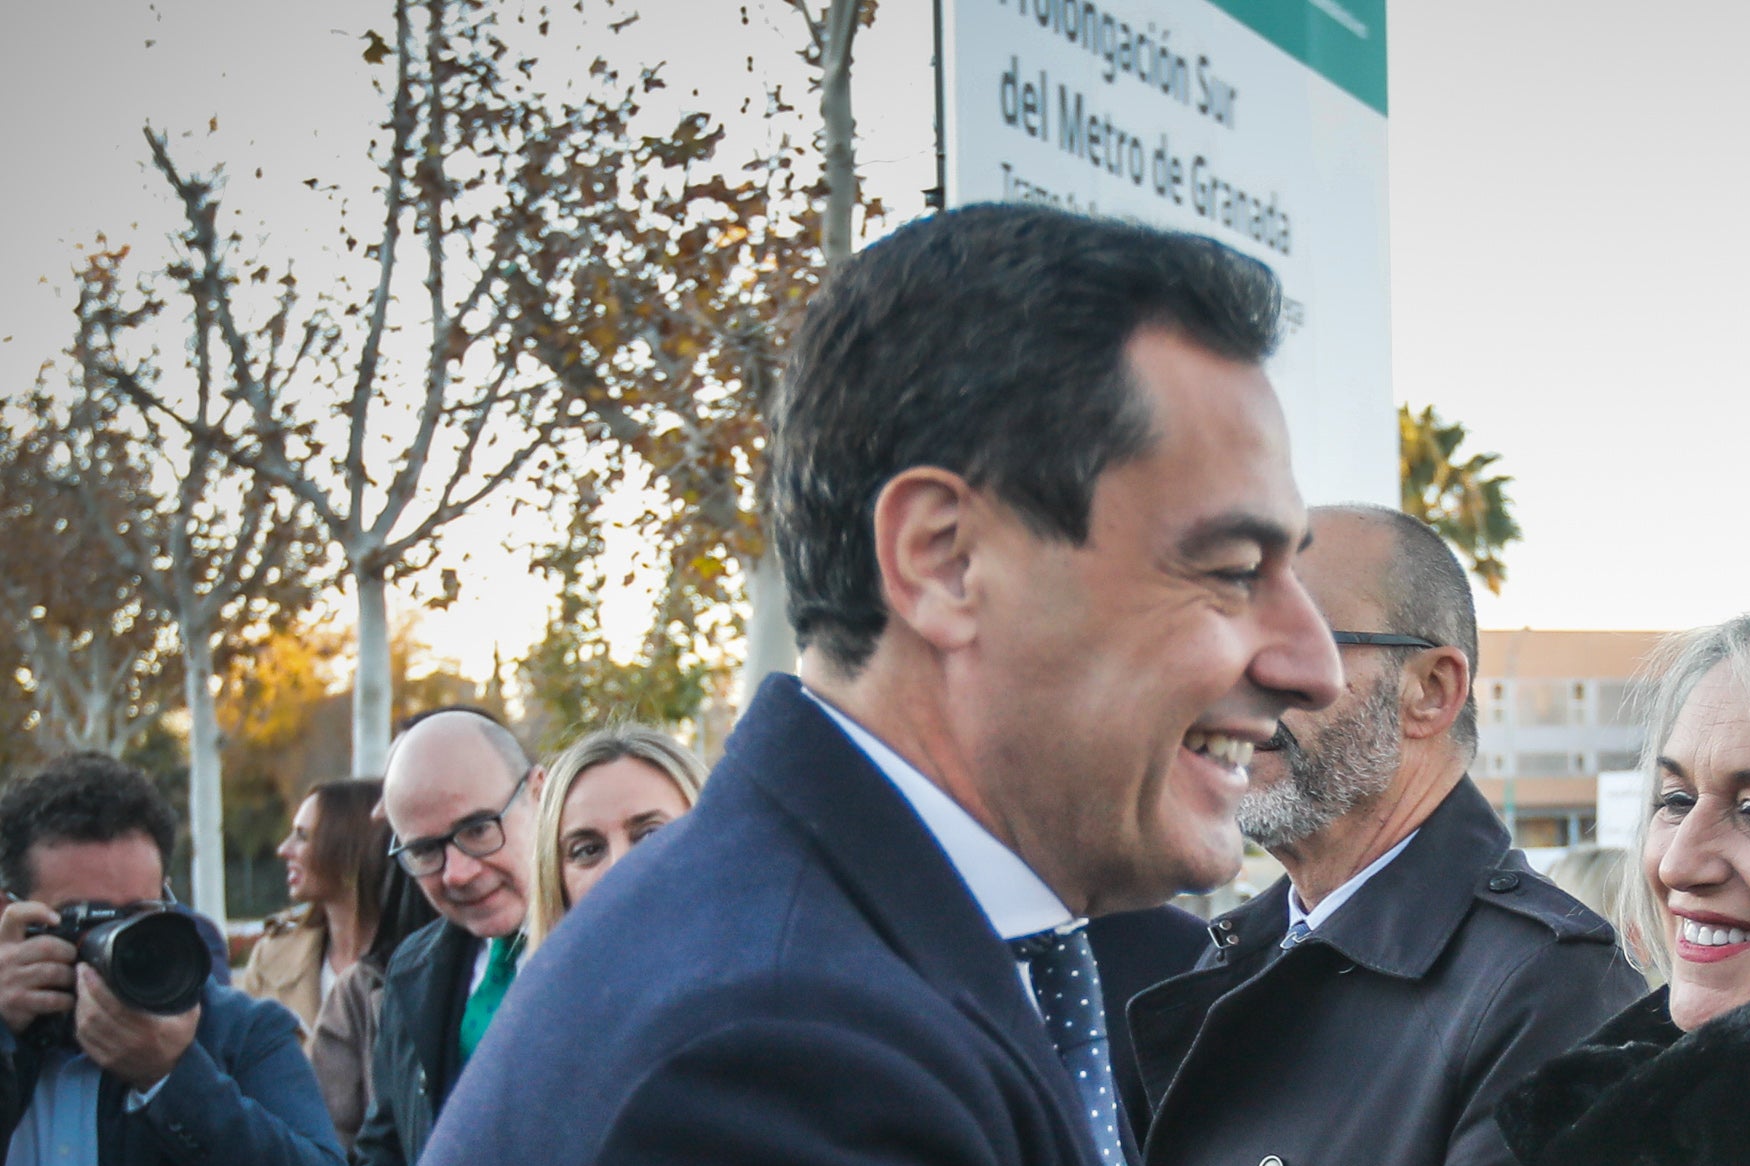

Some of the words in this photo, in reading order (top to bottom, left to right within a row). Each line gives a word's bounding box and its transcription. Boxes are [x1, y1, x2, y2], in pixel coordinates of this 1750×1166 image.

[999, 0, 1188, 105] olongación
[1198, 55, 1237, 129] Sur
[1001, 55, 1047, 141] del
[1058, 83, 1144, 186] Metro
[1153, 133, 1182, 205] de
[1191, 154, 1289, 255] Granada
